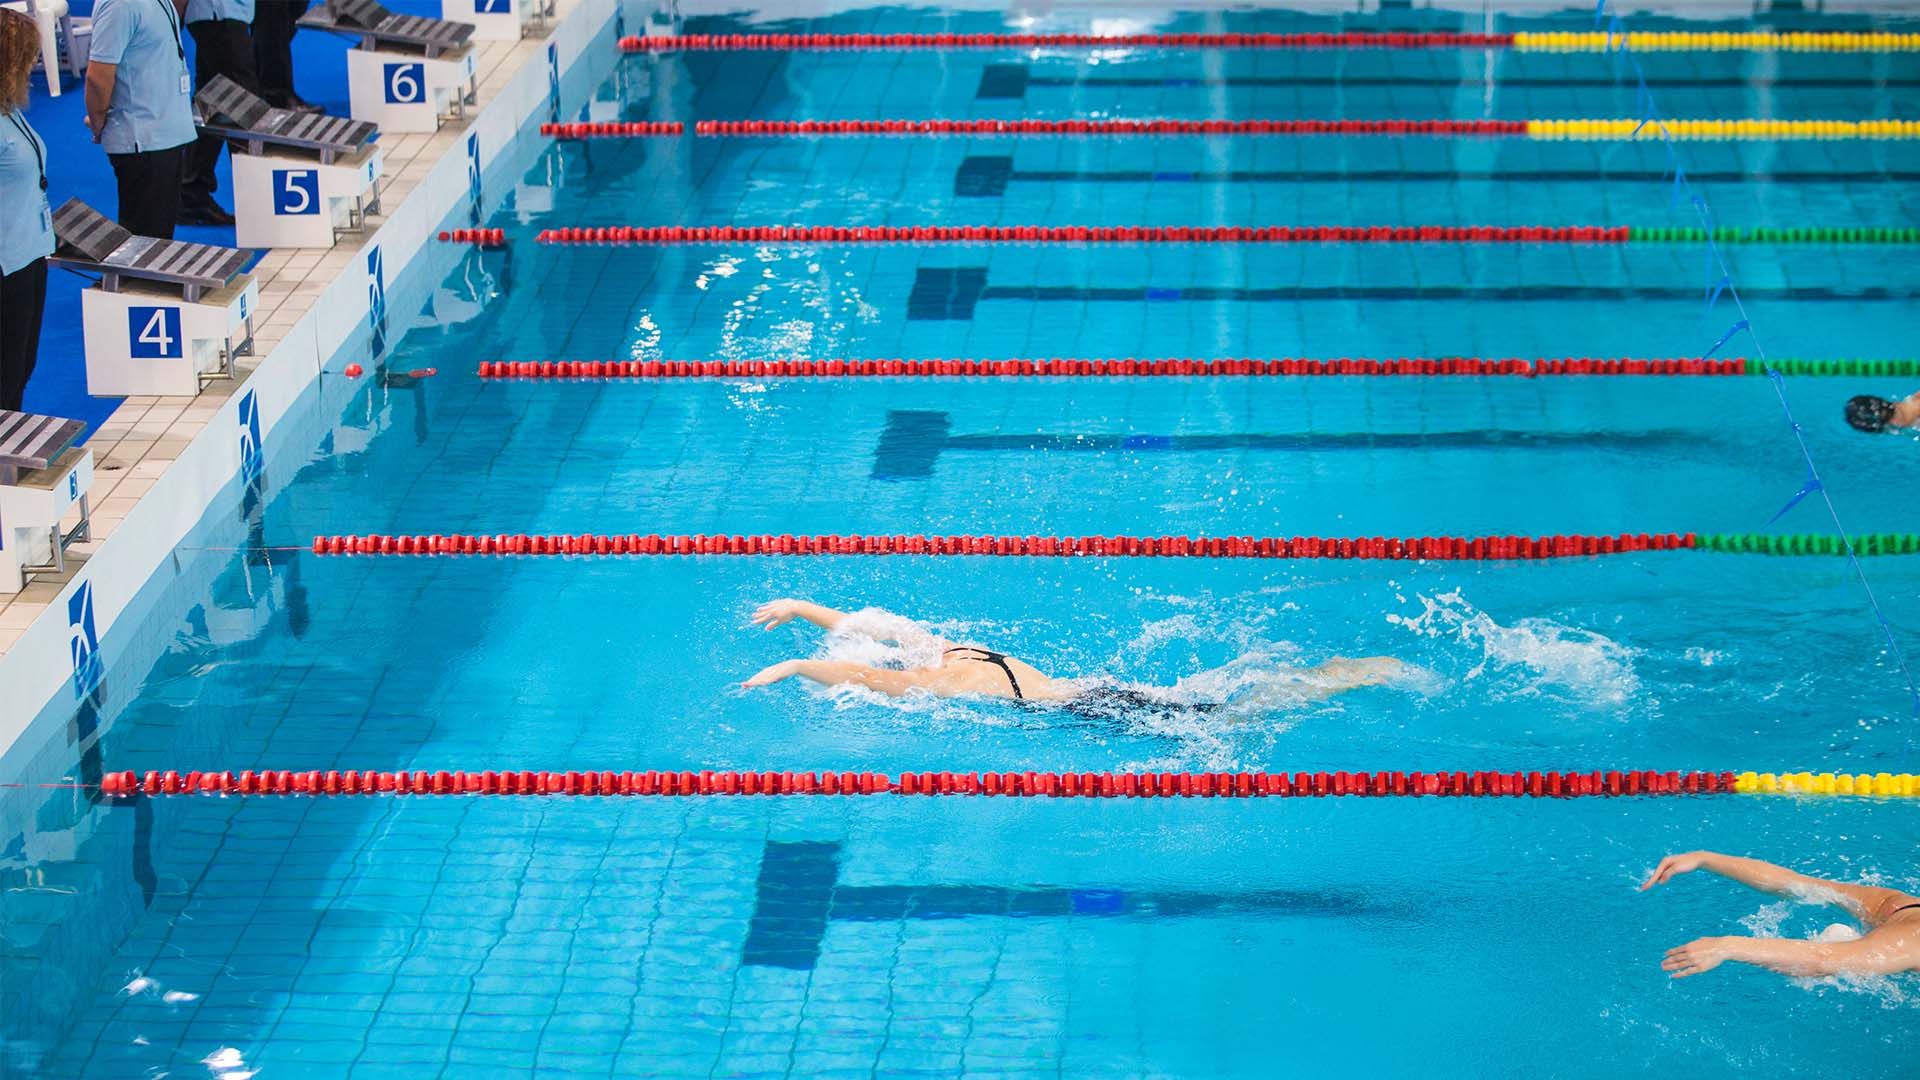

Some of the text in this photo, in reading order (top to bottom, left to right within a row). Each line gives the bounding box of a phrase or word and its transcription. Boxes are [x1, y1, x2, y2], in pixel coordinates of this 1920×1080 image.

[391, 64, 418, 103] 6
[284, 171, 310, 213] 5
[138, 309, 174, 355] 4
